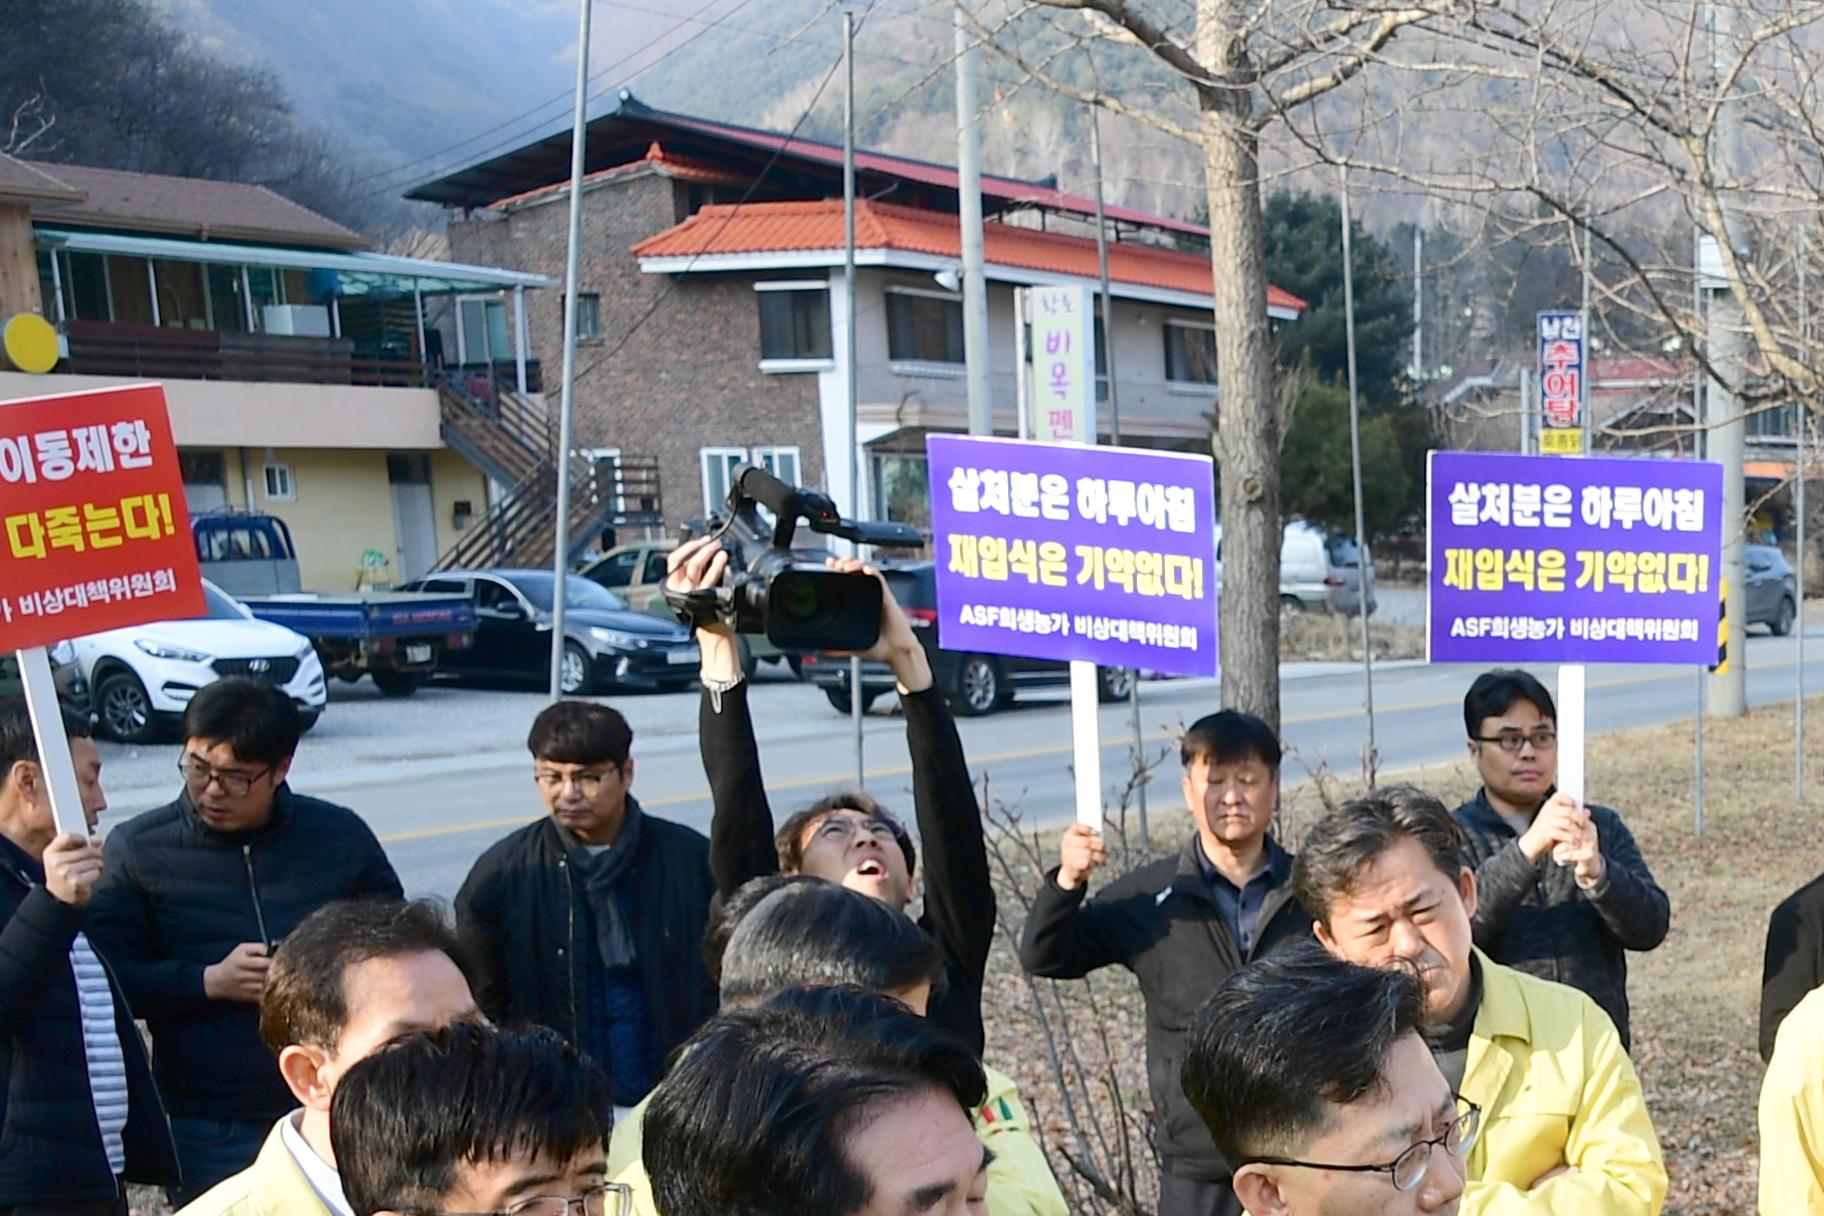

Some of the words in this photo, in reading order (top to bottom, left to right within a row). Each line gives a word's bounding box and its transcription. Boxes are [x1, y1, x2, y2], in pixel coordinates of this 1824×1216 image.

[1543, 341, 1579, 427] 추어탕
[0, 419, 153, 484] 이동제한
[5, 493, 176, 560] 다죽는다!
[948, 466, 1070, 521] 살처분은
[1076, 477, 1196, 534] 하루아침
[1448, 482, 1573, 528] 살처분은
[1581, 484, 1704, 532] 하루아침
[18, 568, 177, 617] 비상대책위원회
[948, 532, 1068, 587] 재입식은
[1074, 544, 1204, 601] 기약없다!
[1442, 547, 1566, 593] 재입식은
[1575, 549, 1710, 594] 기약없다!
[959, 603, 1070, 636] ASF희생농가
[1074, 614, 1198, 651] 비상대책위원회
[1450, 616, 1566, 641] ASF희생농가
[1570, 617, 1699, 642] 비상대책위원회
